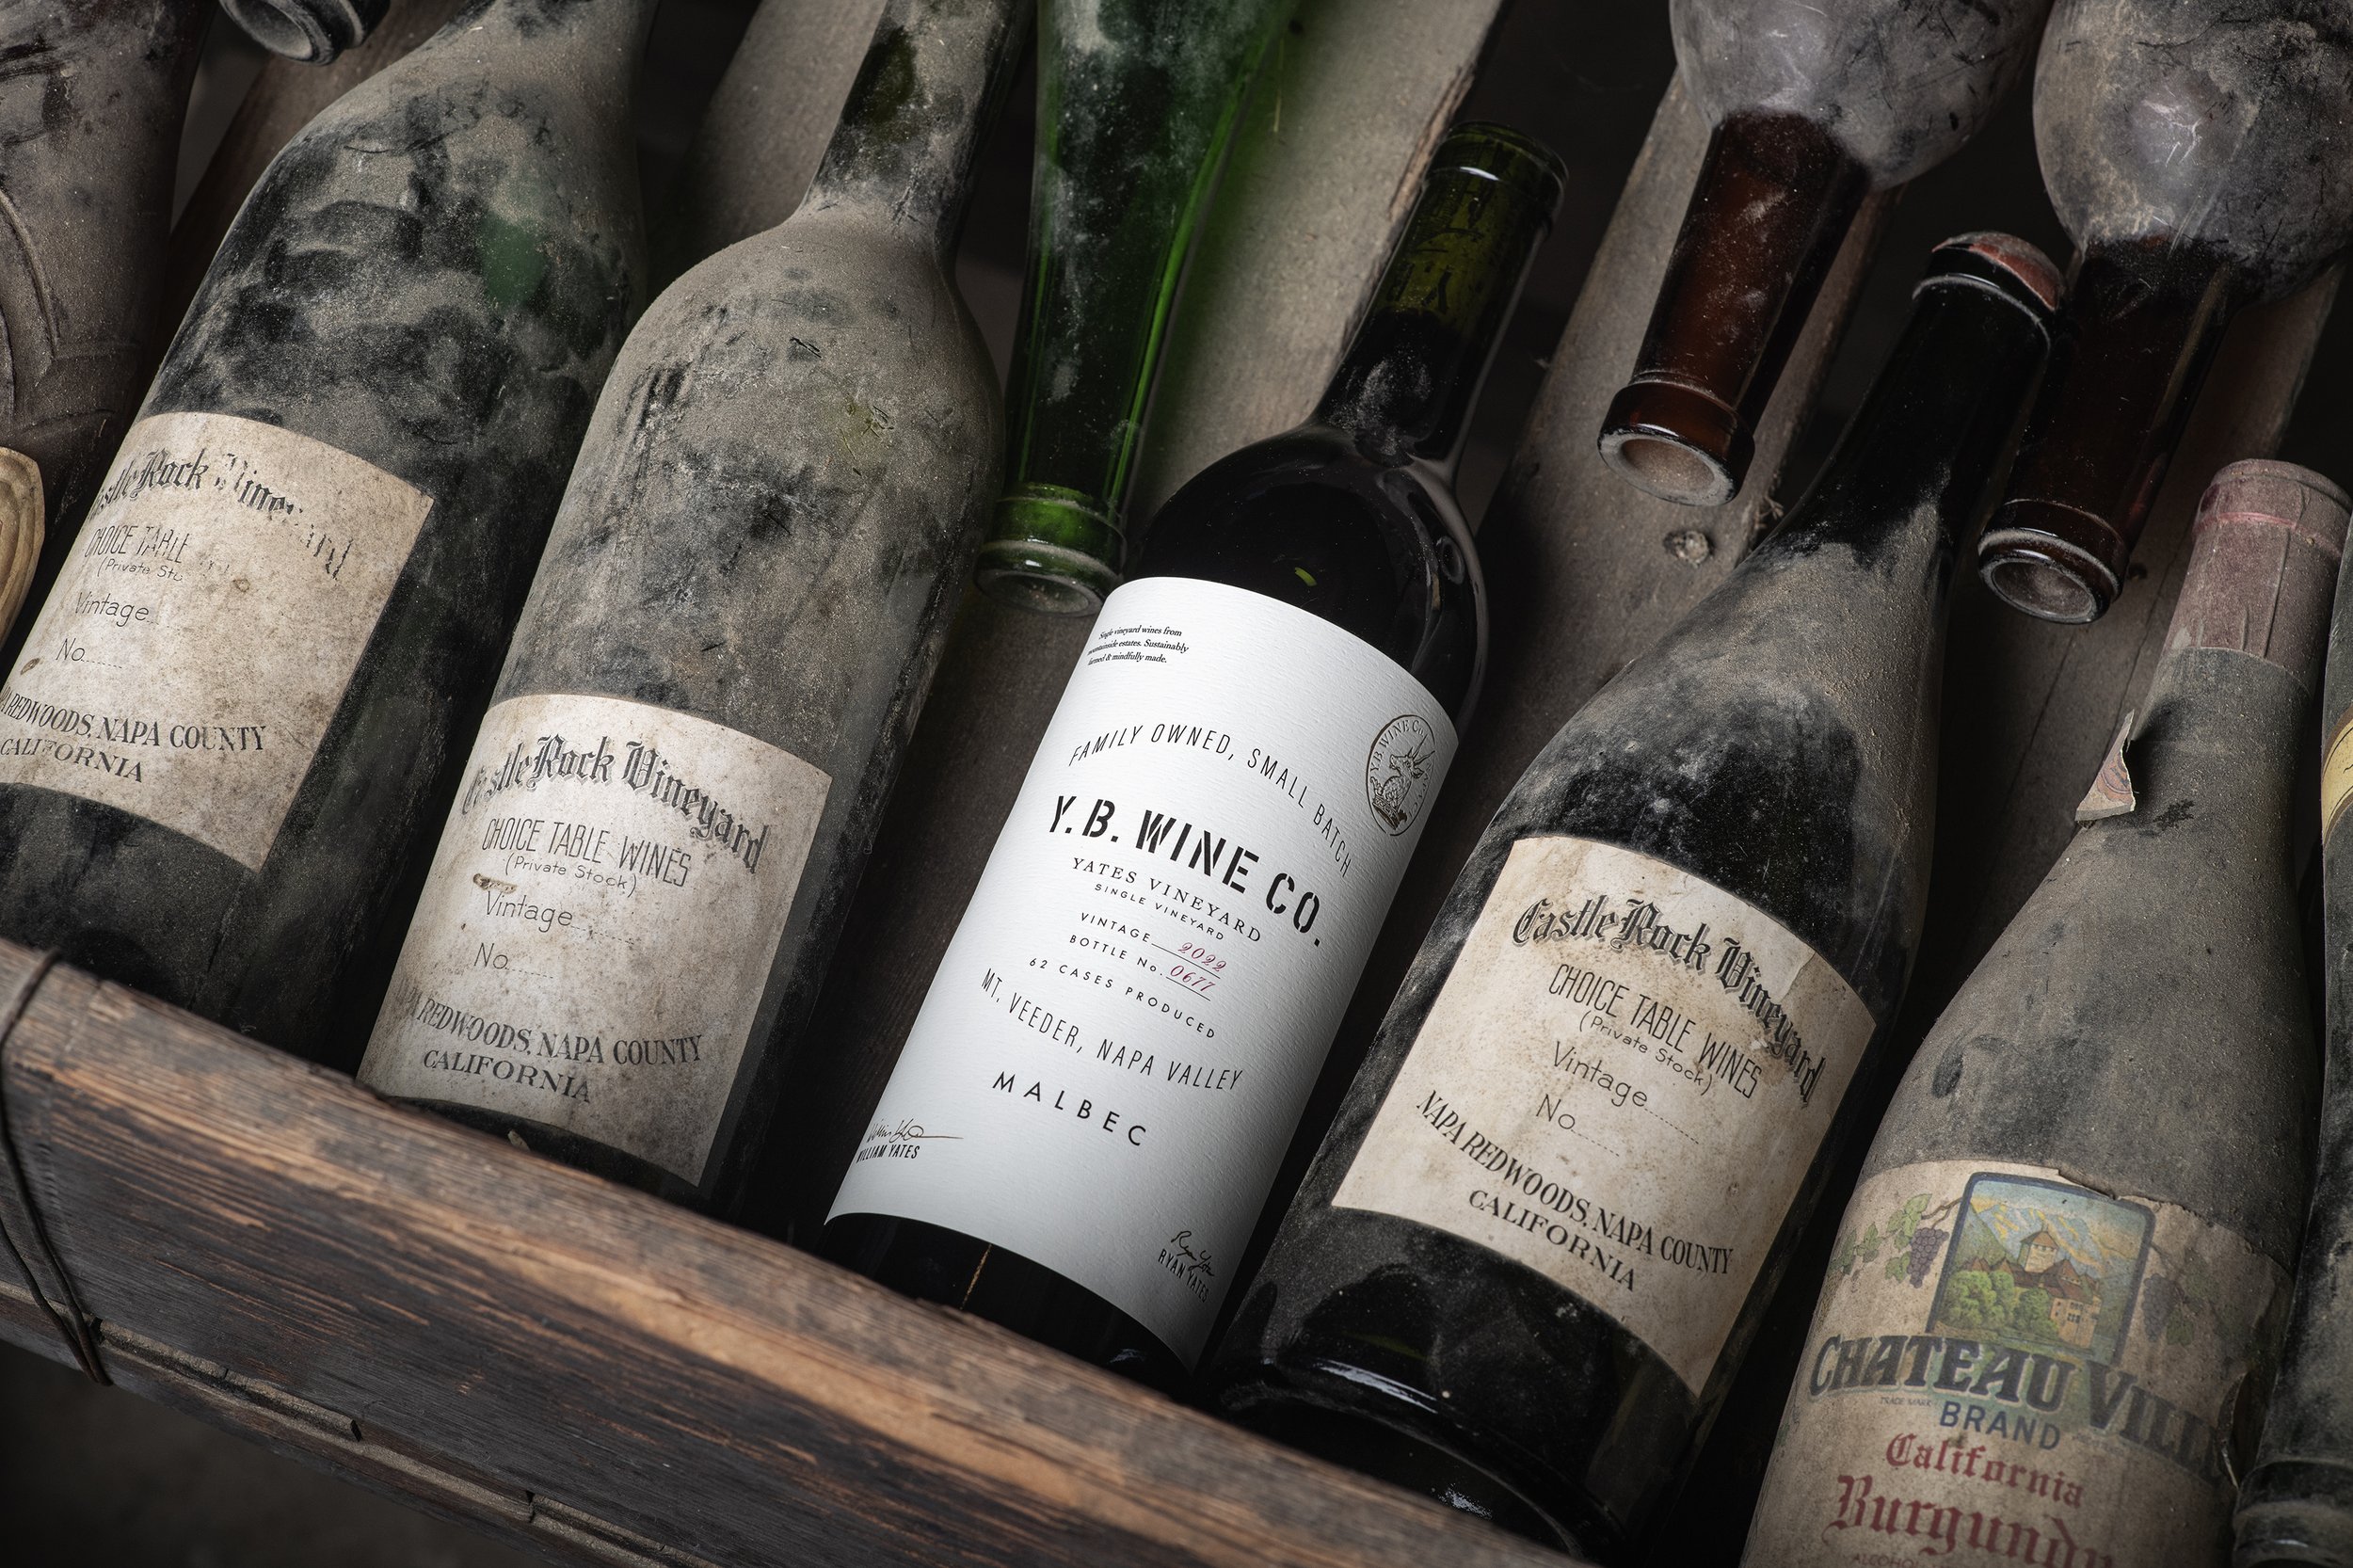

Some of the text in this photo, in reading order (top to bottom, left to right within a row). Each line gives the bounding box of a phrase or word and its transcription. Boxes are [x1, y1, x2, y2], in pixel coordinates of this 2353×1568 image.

[130, 447, 209, 502] Rock
[85, 525, 189, 564] CHOICE TABLE
[74, 591, 149, 627] Vintage
[1114, 625, 1142, 635] vineyard
[1142, 626, 1161, 634] wines
[1163, 626, 1182, 636] from
[1112, 651, 1144, 663] mindfully
[1144, 654, 1167, 663] made.
[1144, 639, 1190, 654] Sustainably
[4, 693, 95, 739] REDWOODS,
[96, 716, 160, 746] NAPA
[169, 726, 266, 751] COUNTY
[1379, 719, 1410, 748] WINE
[1, 738, 142, 782] CALIFORNIA
[526, 734, 615, 791] Rock
[622, 741, 770, 873] Vineyard
[1069, 724, 1352, 878] FAMILY OWNED, SMALL BATCH
[481, 817, 691, 888] CHOICE TABLE WINES
[504, 853, 637, 897] (Private Stock)
[1135, 809, 1259, 894] WINE
[1265, 872, 1321, 948] CO.
[486, 891, 573, 932] Vintage
[1072, 857, 1261, 943] YATES VINEYARD
[1095, 883, 1224, 940] SINGLE VINEYARD
[1070, 935, 1216, 992] BOTTLE No. 0677
[1081, 912, 1227, 973] VINTAGE 2022
[1030, 958, 1215, 1039] 62 CASES PRODUCED
[1513, 894, 1827, 1109] Castle Rock Vineyard
[416, 998, 532, 1056] REDWOODS,
[536, 1032, 604, 1064] NAPA
[613, 1035, 702, 1064] COUNTY
[1009, 993, 1082, 1053] VEEDER,
[1096, 1039, 1154, 1076] NAPA
[1167, 1061, 1242, 1091] VALLEY
[1548, 964, 1763, 1098] CHOICE TABLE WINES
[1579, 1010, 1713, 1096] (Private Stock)
[424, 1049, 590, 1102] CALIFORNIA
[1552, 1041, 1648, 1108] Vintage
[992, 1071, 1146, 1146] MALBEC
[888, 1144, 920, 1159] YATES
[1416, 1090, 1733, 1274] NAPA REDWOODS, NAPA COUNTY
[1469, 1190, 1635, 1292] CALIFORNIA
[1158, 1248, 1186, 1279] RYAN
[1187, 1271, 1209, 1303] YATES
[1809, 1334, 2076, 1412] CHATEAU
[1939, 1400, 2061, 1451] BRAND
[1885, 1432, 2085, 1508] California
